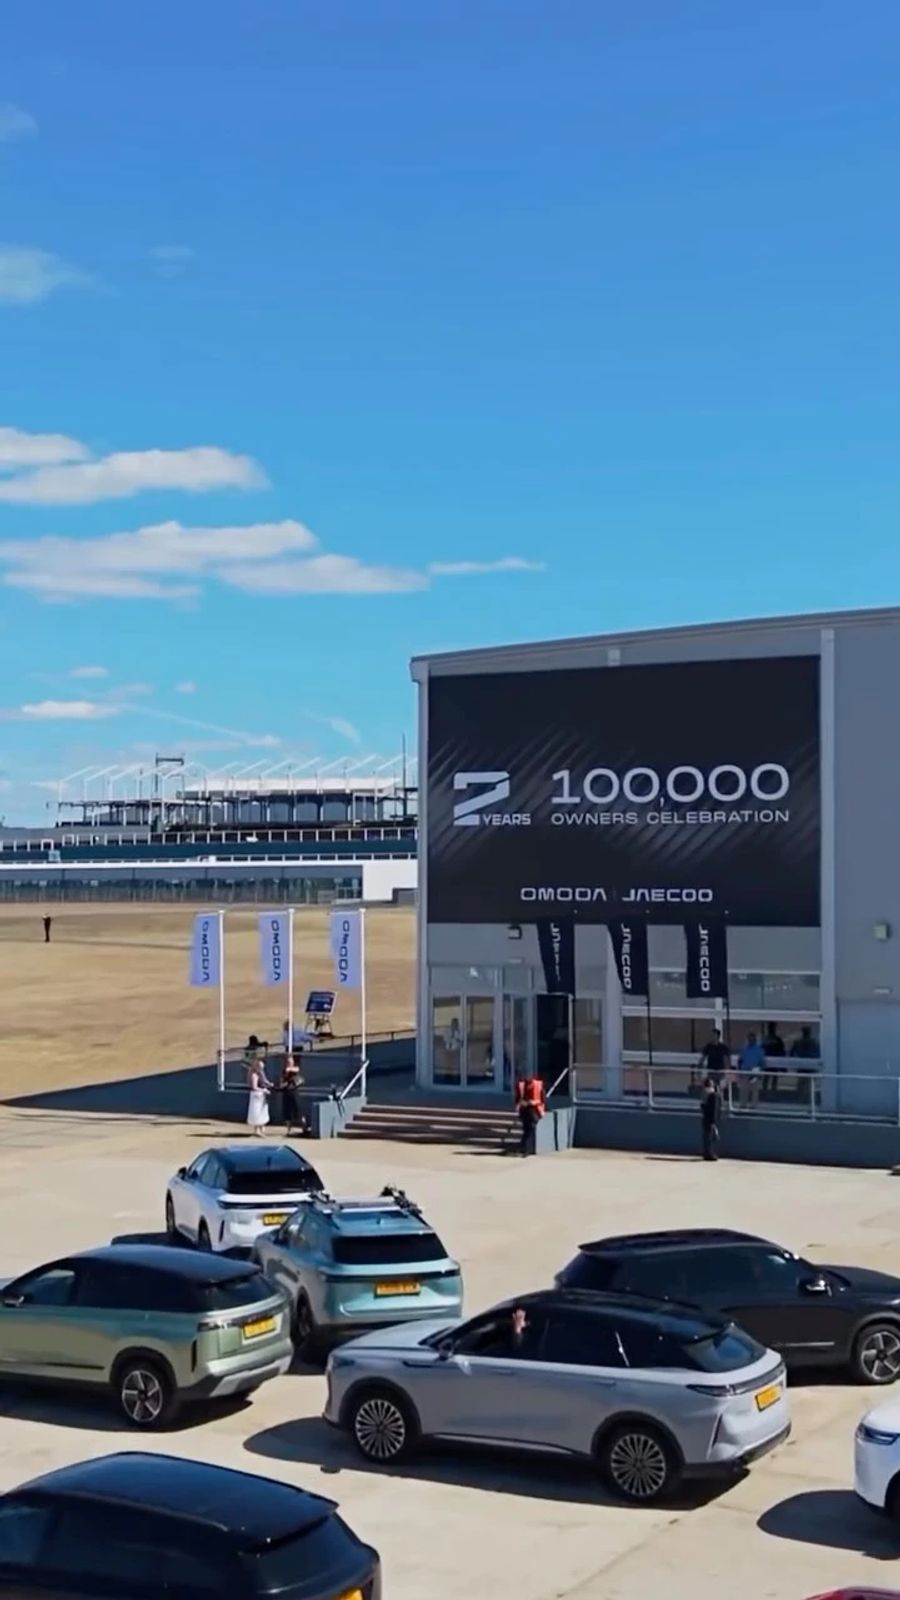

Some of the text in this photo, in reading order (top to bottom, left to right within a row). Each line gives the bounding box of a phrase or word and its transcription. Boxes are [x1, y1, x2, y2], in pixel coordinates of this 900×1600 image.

[453, 770, 510, 827] 2
[551, 763, 790, 807] 100,000
[483, 813, 531, 826] YEARS
[551, 809, 790, 825] OWNERS CELEBRATION
[520, 887, 713, 902] OMODA JAECOO
[271, 920, 281, 981] OMODA
[338, 920, 350, 982] OMODA
